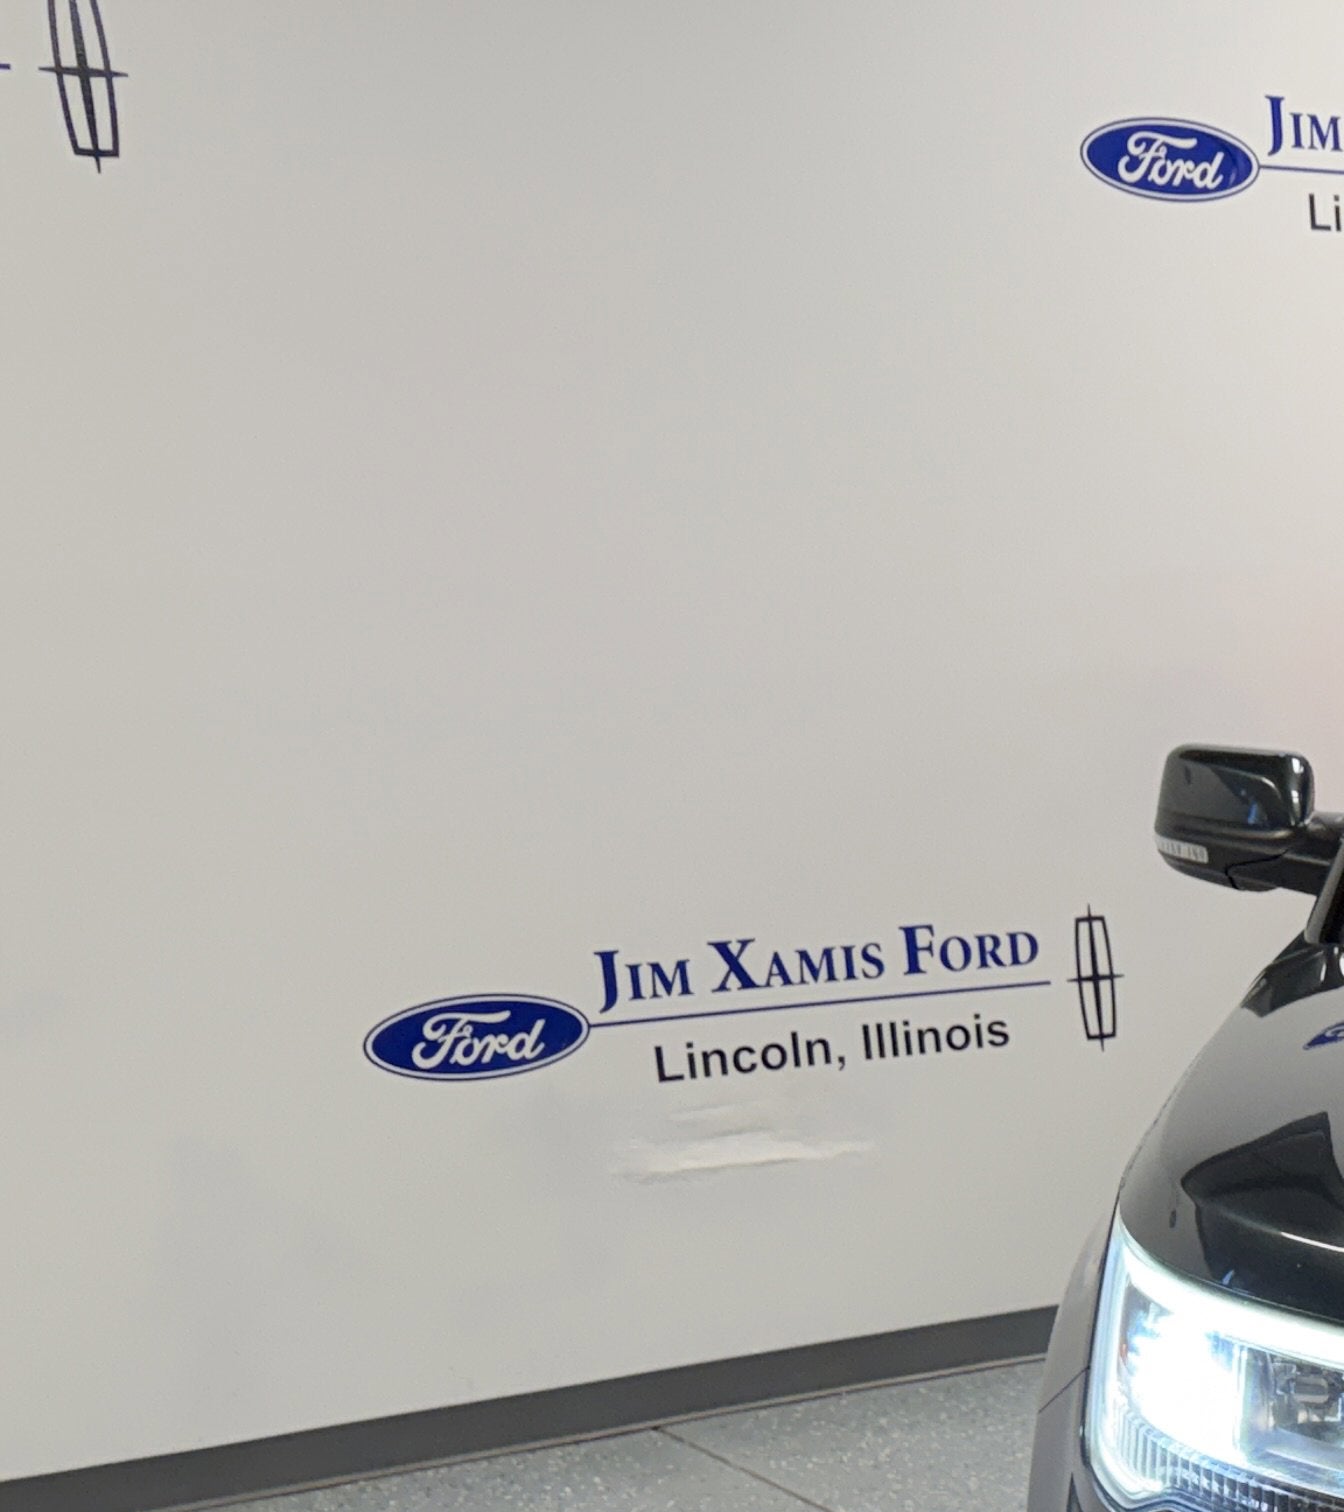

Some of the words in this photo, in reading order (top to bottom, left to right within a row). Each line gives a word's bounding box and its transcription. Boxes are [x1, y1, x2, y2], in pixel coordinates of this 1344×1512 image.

[1117, 131, 1224, 189] Ford
[409, 1010, 545, 1068] Ford
[655, 1031, 846, 1083] Lincoln,
[862, 1014, 1010, 1061] Illinois
